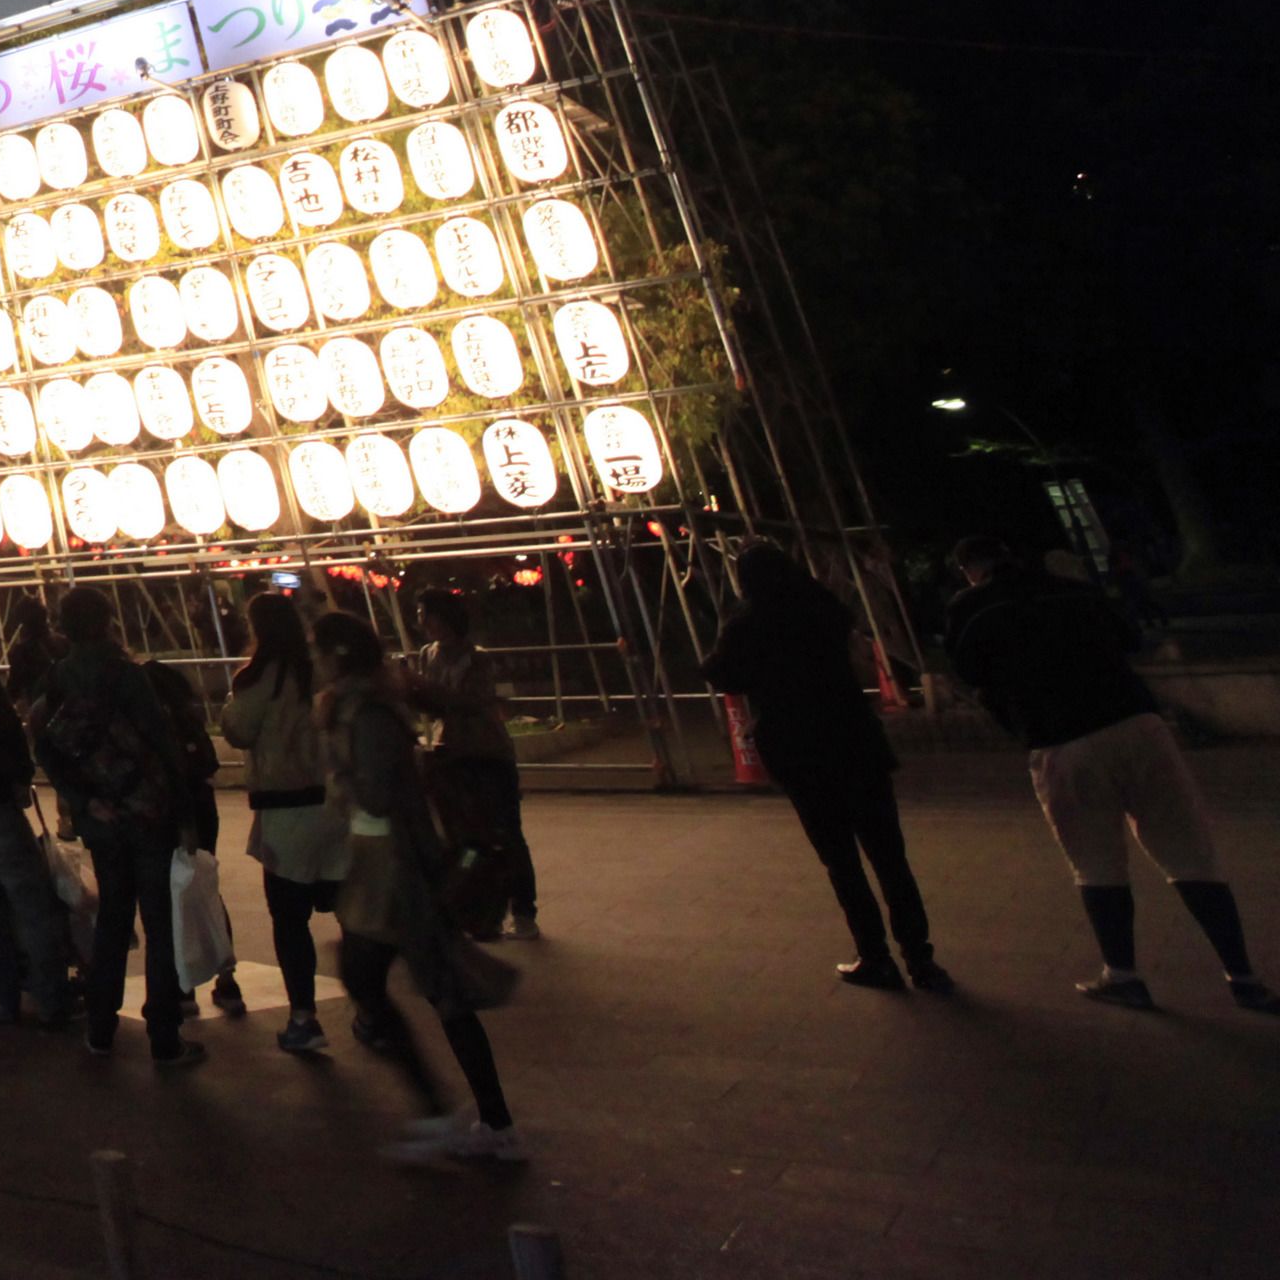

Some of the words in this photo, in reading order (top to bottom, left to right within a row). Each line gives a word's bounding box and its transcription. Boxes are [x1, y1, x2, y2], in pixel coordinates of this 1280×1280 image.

[208, 83, 241, 145] 上野町町会
[285, 160, 324, 214] 吉也
